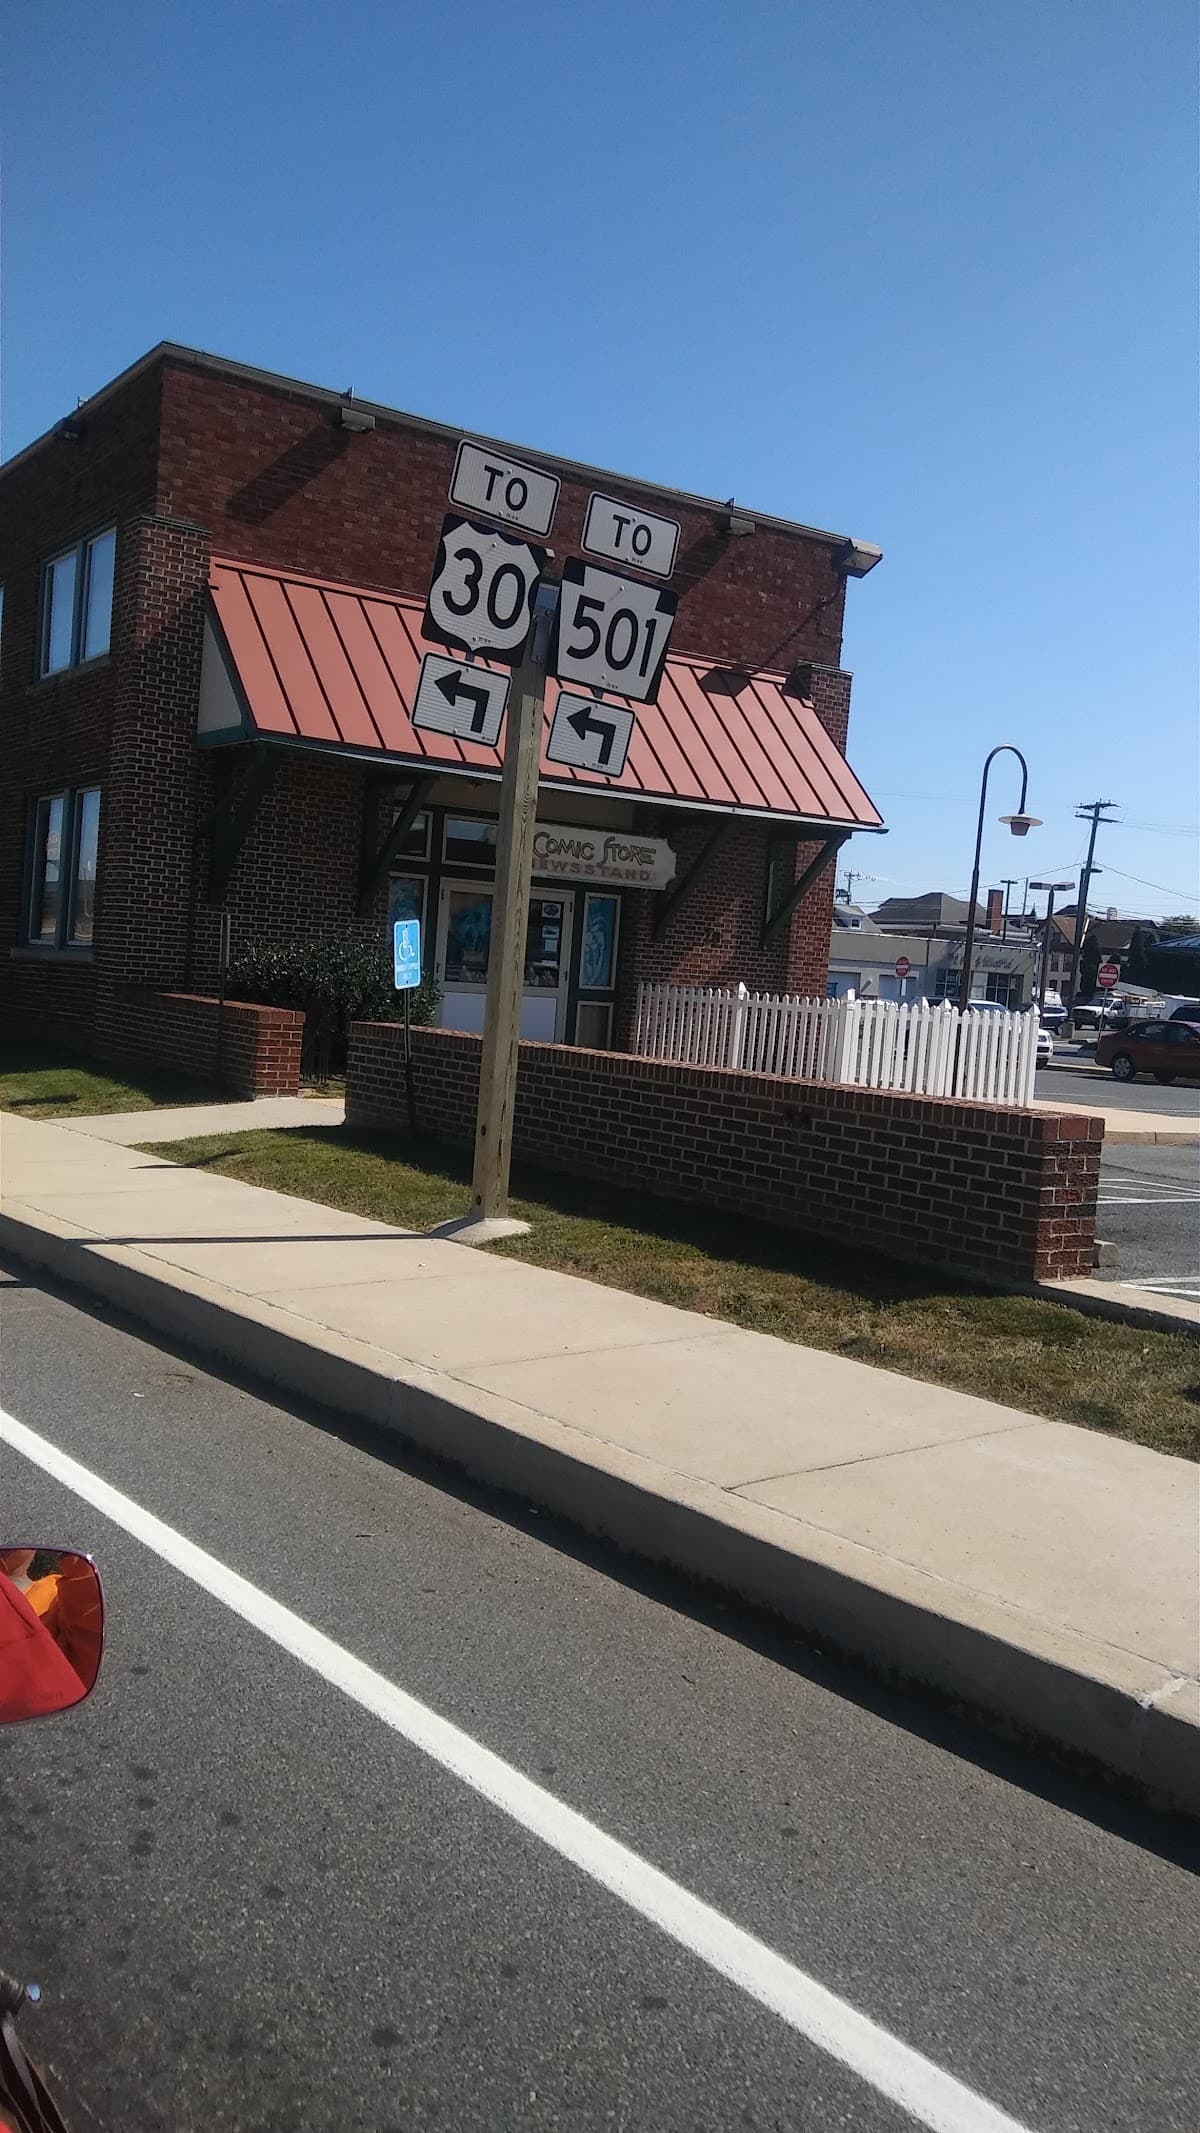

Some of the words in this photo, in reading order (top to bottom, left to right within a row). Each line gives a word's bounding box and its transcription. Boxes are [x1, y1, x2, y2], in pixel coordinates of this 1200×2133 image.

[484, 465, 528, 511] TO
[612, 514, 652, 556] TO
[442, 547, 526, 630] 30
[566, 594, 658, 678] 501
[532, 857, 651, 881] EWSSTAND
